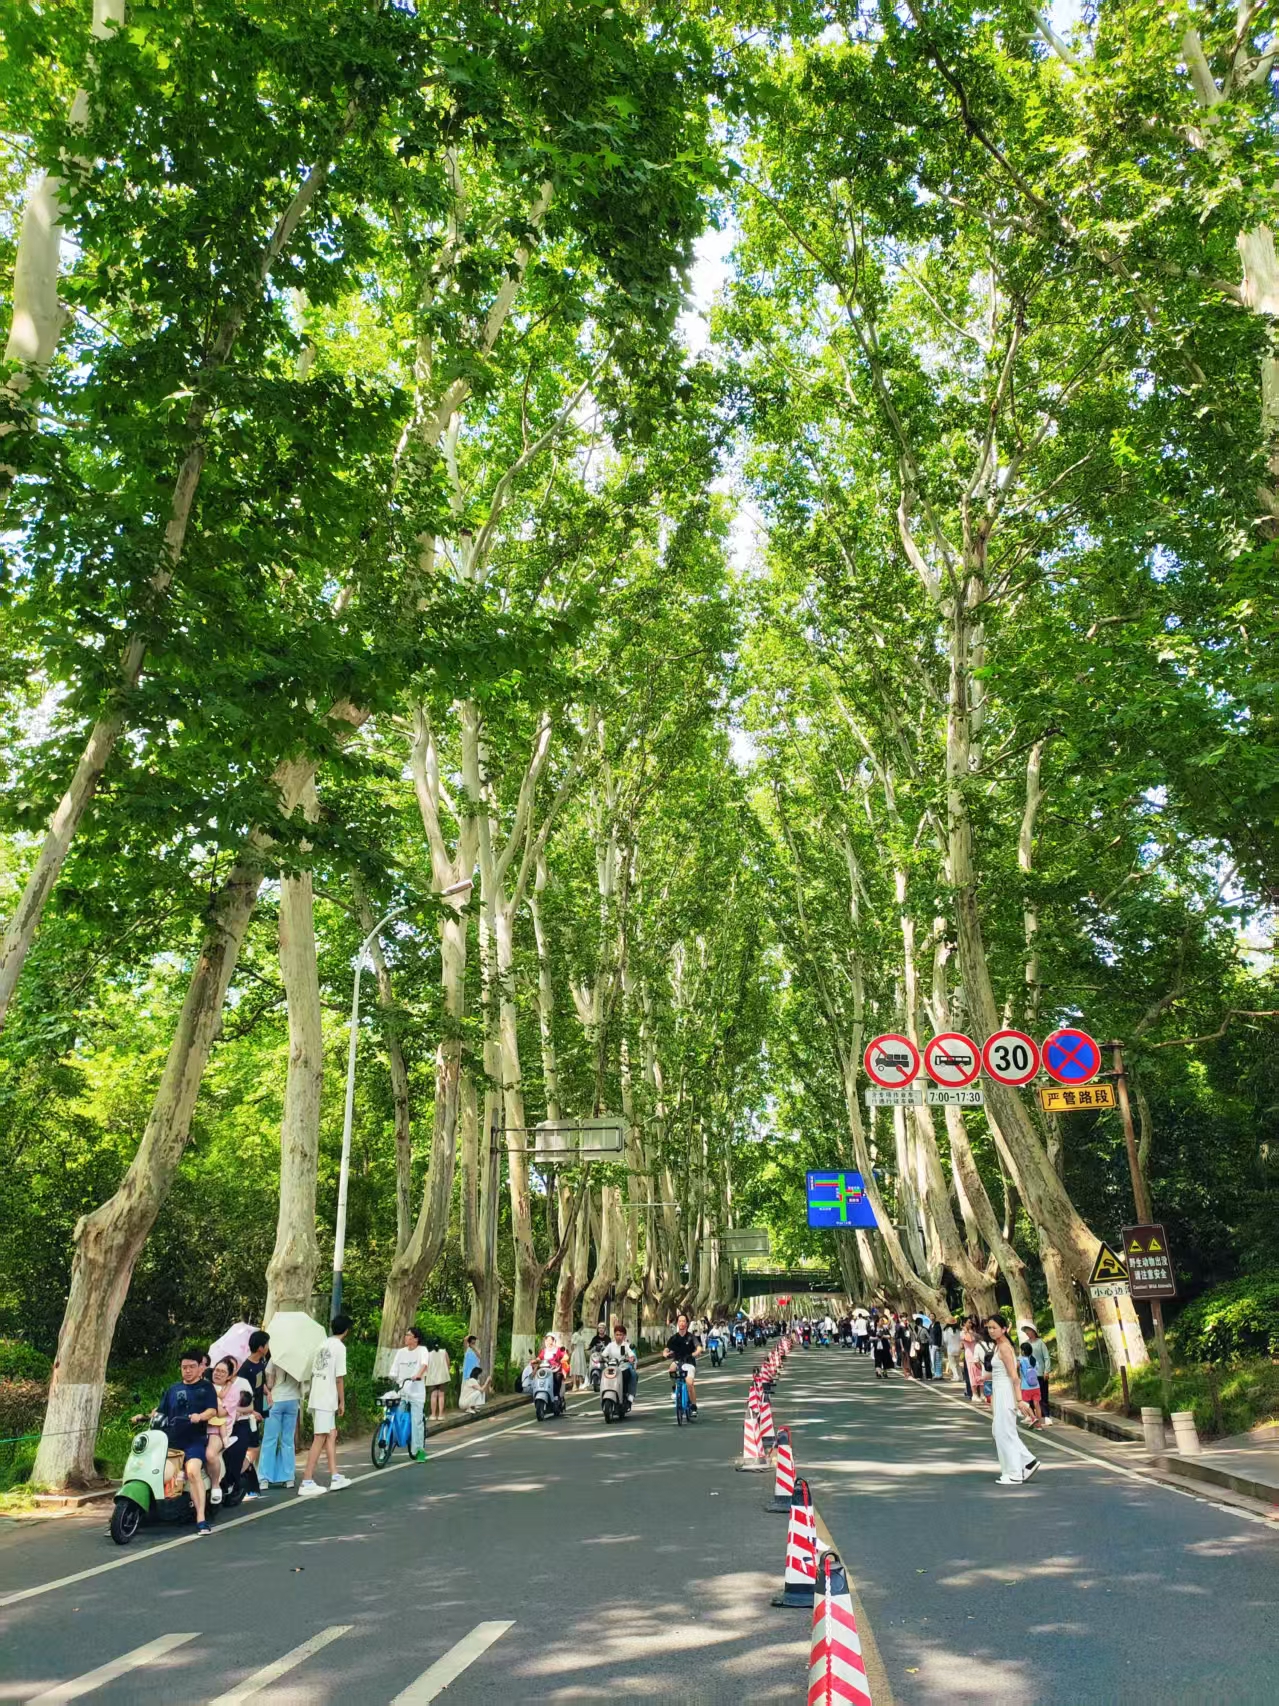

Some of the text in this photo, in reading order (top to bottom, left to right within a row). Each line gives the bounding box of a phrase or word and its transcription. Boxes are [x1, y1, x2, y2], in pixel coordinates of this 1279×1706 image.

[994, 1045, 1028, 1071] 30
[930, 1092, 980, 1102] 7:00-17:30
[1047, 1089, 1109, 1107] 严管路段
[1128, 1255, 1168, 1268] 野生动物出没
[1134, 1268, 1167, 1280] 请注意安全
